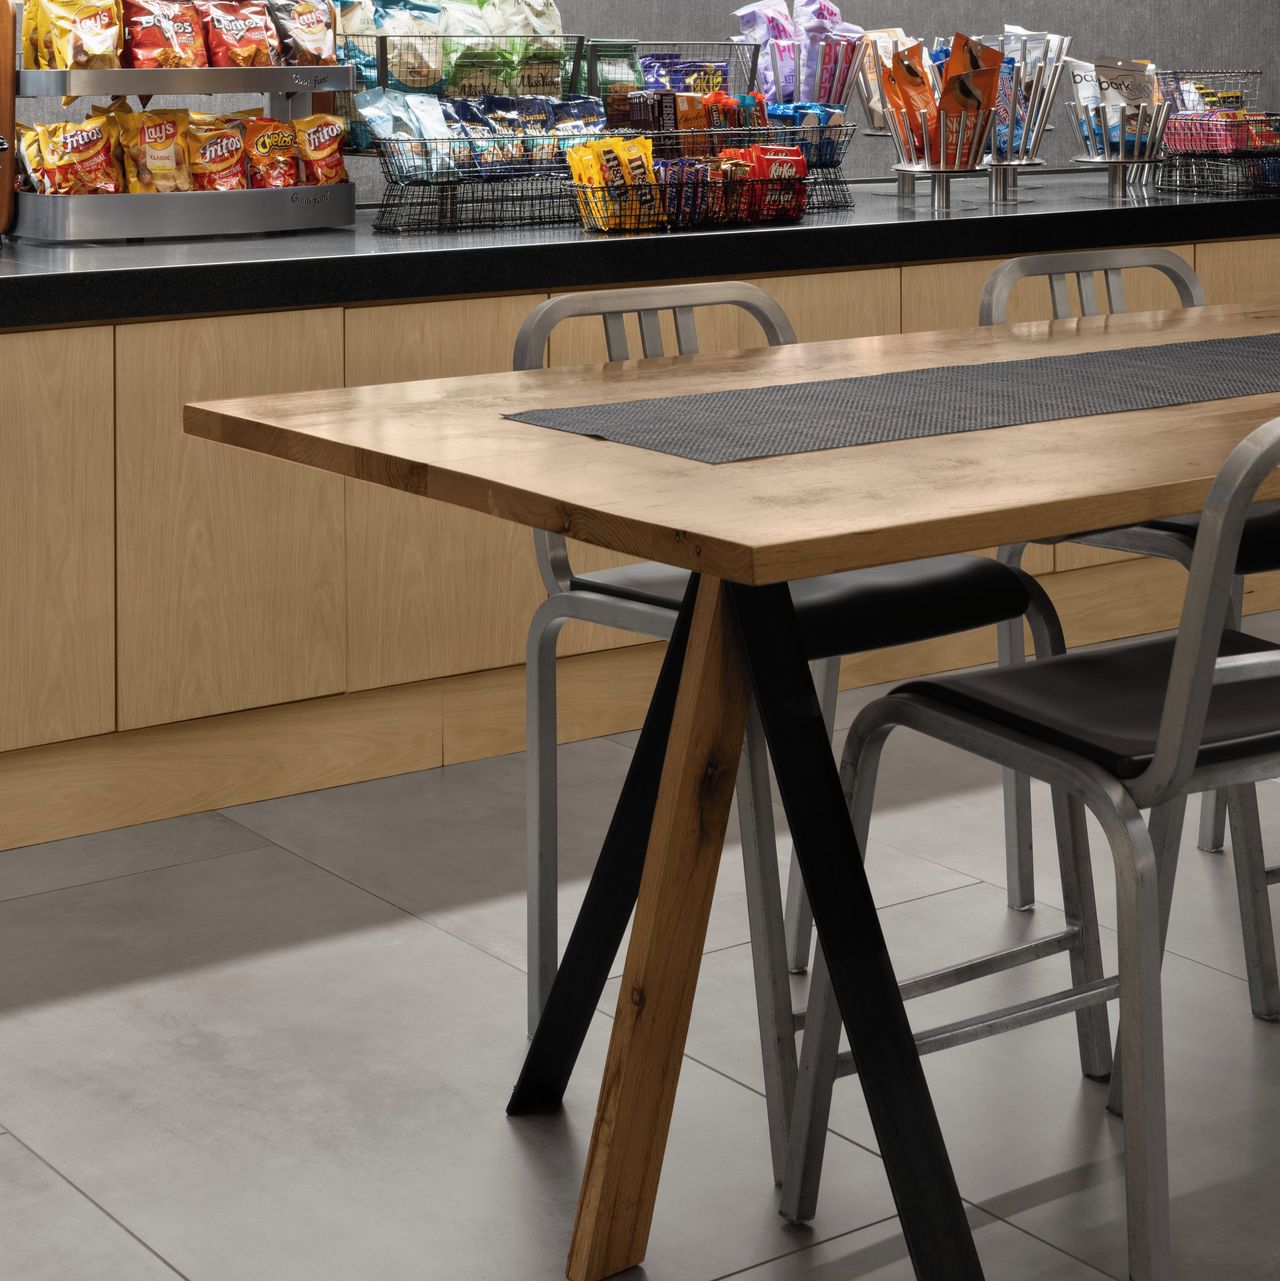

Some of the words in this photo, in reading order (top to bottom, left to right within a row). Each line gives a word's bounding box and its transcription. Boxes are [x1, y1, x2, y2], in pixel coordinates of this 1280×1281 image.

[710, 105, 720, 126] KIND
[62, 127, 102, 153] Fritos
[144, 122, 175, 144] Lay's
[200, 136, 241, 163] Fritos
